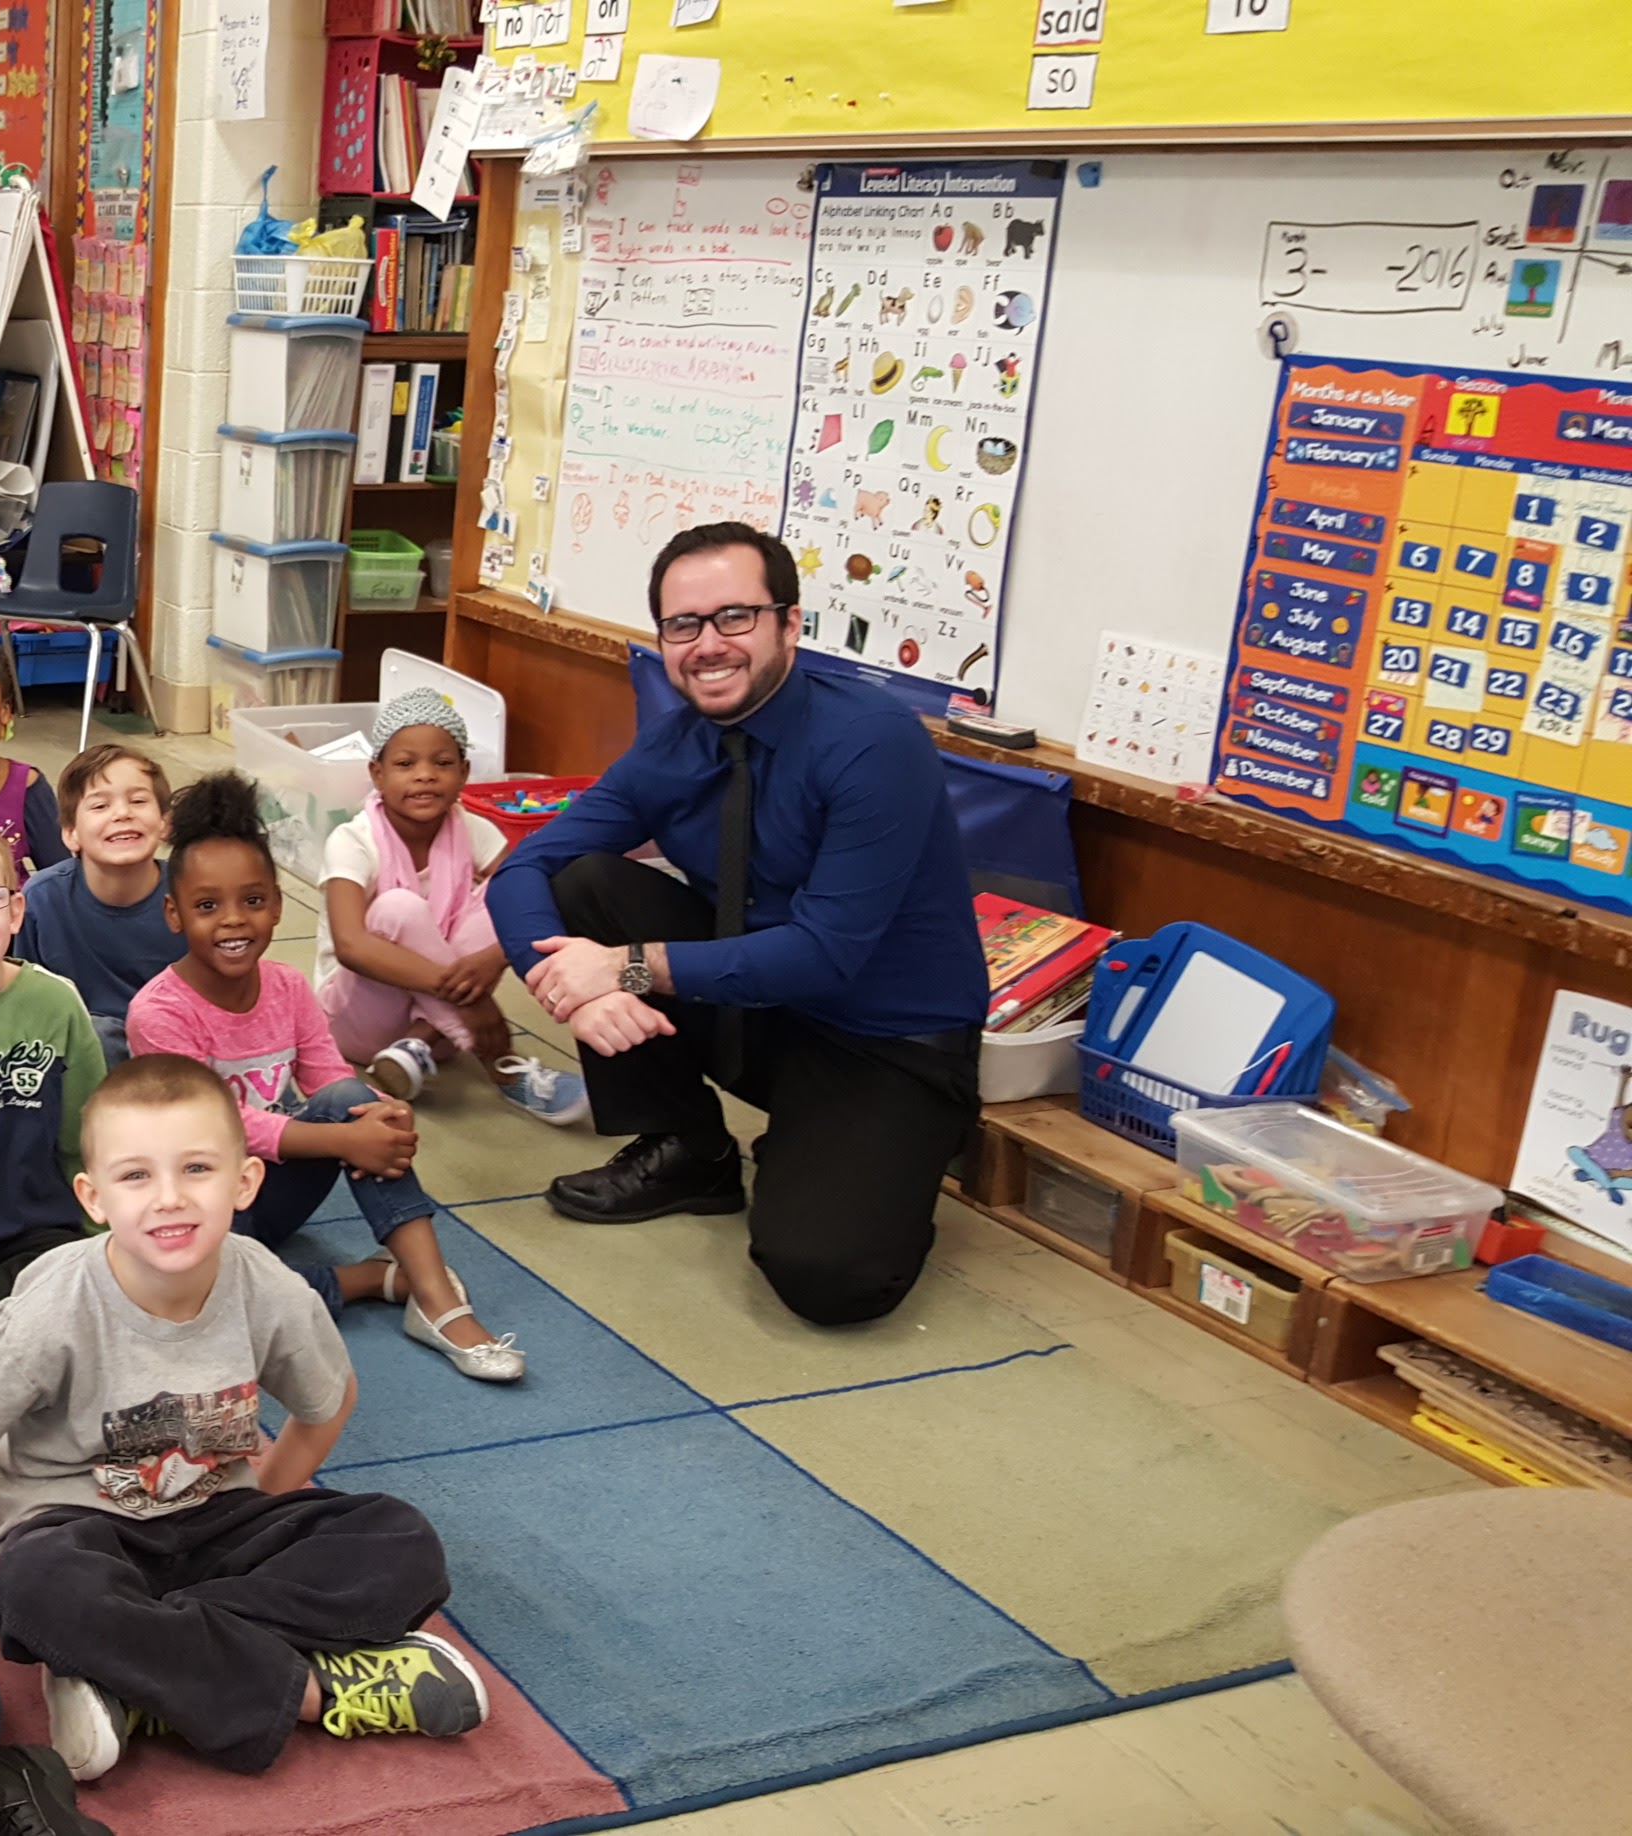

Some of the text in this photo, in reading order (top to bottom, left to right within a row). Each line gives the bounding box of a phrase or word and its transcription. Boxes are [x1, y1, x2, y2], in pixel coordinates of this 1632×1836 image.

[504, 0, 619, 37] no not on
[1039, 0, 1100, 36] said
[1045, 67, 1077, 94] so
[859, 171, 1017, 196] Leveled Literacy Intervention
[617, 216, 627, 236] I
[701, 219, 730, 234] words
[738, 223, 759, 236] and
[821, 204, 927, 220] Alphabet Linking Chart
[387, 231, 397, 260] Center
[819, 226, 842, 237] abcd
[846, 226, 861, 239] efg
[891, 227, 922, 240] lmnop
[385, 261, 396, 297] Learning
[614, 266, 627, 288] I
[1385, 242, 1471, 293] -2016
[603, 324, 616, 344] I
[602, 385, 613, 409] I
[1289, 380, 1417, 408] Months of the Year
[1454, 374, 1509, 394] Season
[1309, 408, 1379, 434] January
[1304, 442, 1379, 468] February
[1420, 449, 1573, 480] Sunday Monday Tuesday
[608, 463, 618, 485] I
[1305, 508, 1347, 532] April
[1526, 498, 1608, 546] 1 2
[1300, 541, 1337, 566] May
[1410, 546, 1599, 600] 6 7 8 9
[1289, 582, 1330, 603] June
[1287, 607, 1323, 631] July
[1394, 599, 1425, 624] 13
[1450, 611, 1481, 635] 14
[1501, 621, 1532, 646] 15
[1553, 628, 1585, 655] 16
[1269, 629, 1329, 657] August
[1249, 671, 1335, 703] September
[1383, 648, 1417, 670] 20
[1431, 657, 1463, 684] 21
[1487, 672, 1523, 697] 22
[1538, 687, 1576, 716] 23
[1253, 701, 1320, 733] October
[1245, 728, 1320, 762] November
[1367, 714, 1507, 752] 27 28 29
[1239, 760, 1314, 791] December
[1359, 792, 1391, 807] cold
[1520, 833, 1560, 853] sunny
[1575, 848, 1617, 868] cloudy
[1568, 1010, 1631, 1057] Rug
[15, 1072, 38, 1088] 55
